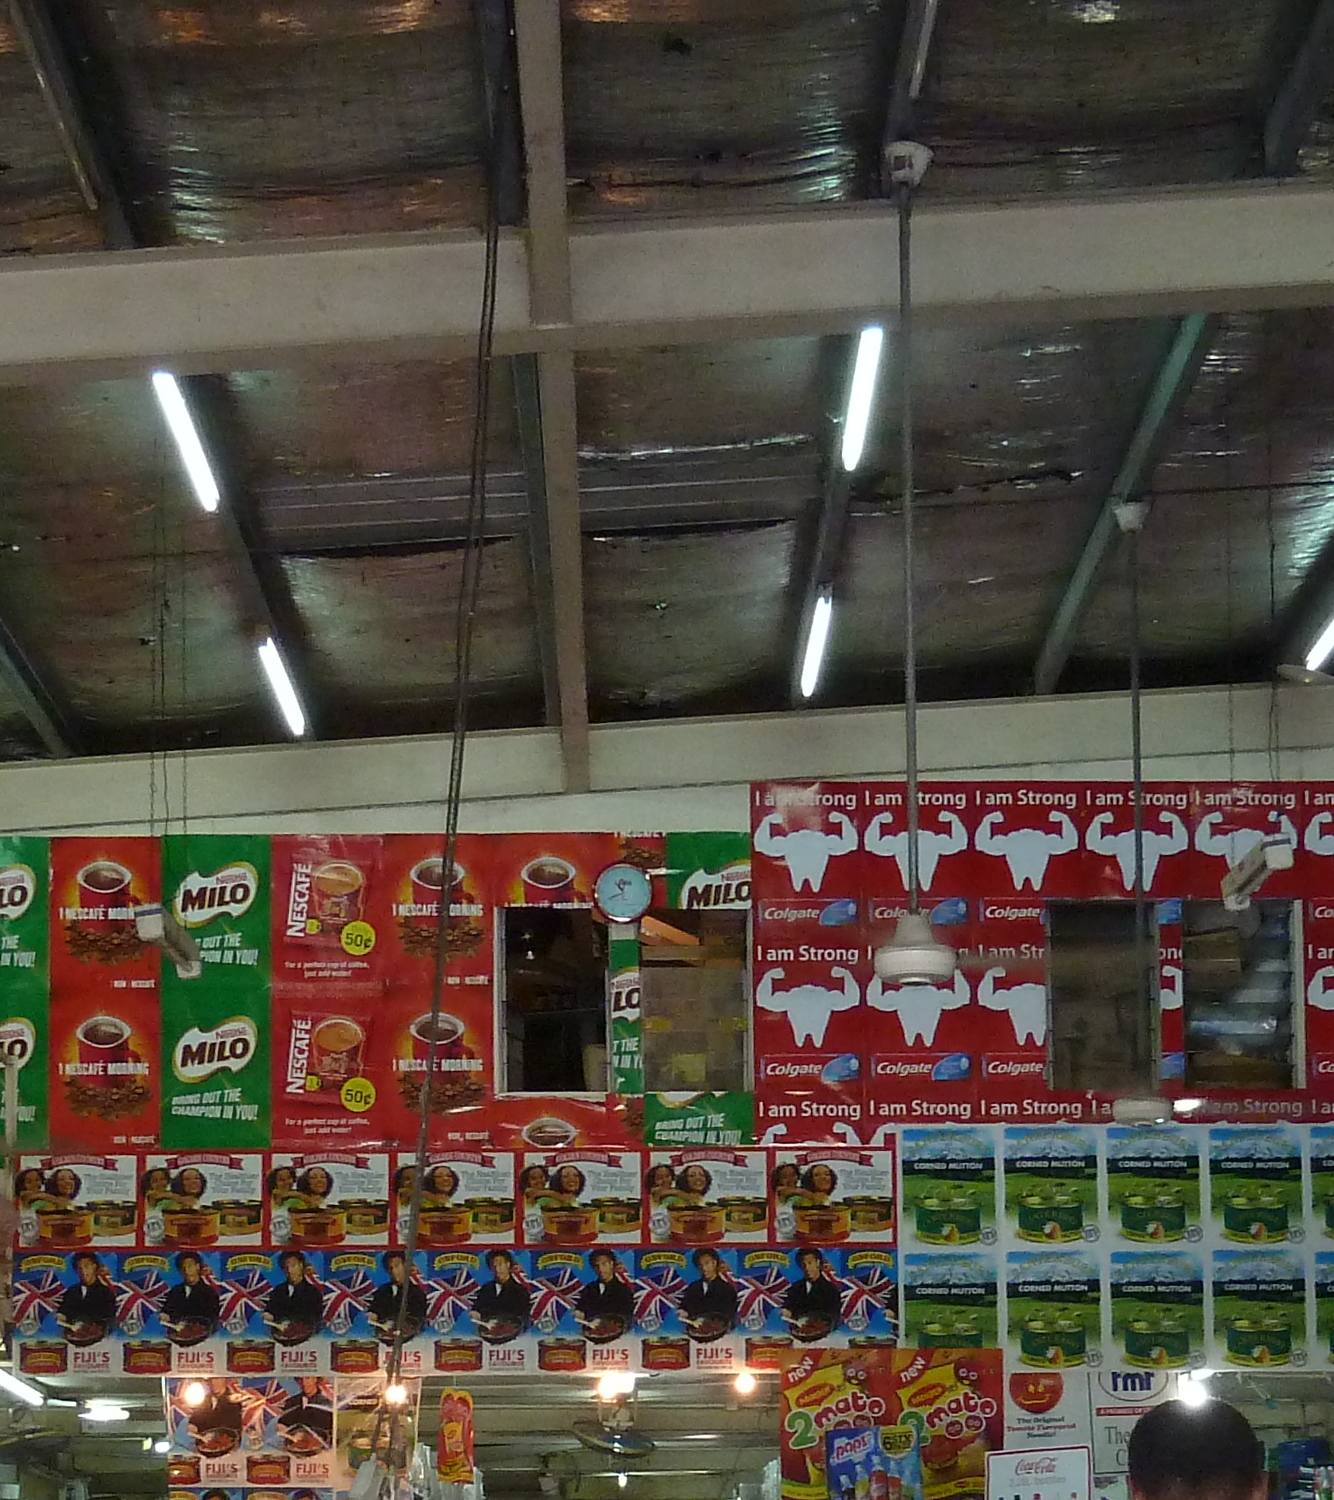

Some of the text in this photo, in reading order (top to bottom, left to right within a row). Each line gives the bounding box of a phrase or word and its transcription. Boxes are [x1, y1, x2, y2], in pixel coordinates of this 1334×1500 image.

[985, 793, 1012, 805] am
[1017, 790, 1077, 808] Strong
[180, 883, 250, 914] MILO
[687, 881, 751, 909] MILO
[765, 907, 820, 921] Colgate
[768, 949, 794, 960] am
[799, 946, 858, 963] Strong
[180, 1037, 250, 1068] MILO
[877, 1062, 932, 1076] Colgate
[879, 1104, 907, 1116] am
[911, 1100, 972, 1119] Strong
[177, 1351, 214, 1364] FIJI'S
[488, 1349, 525, 1363] FIJI'S
[788, 1357, 814, 1383] new
[900, 1356, 926, 1383] new
[785, 1410, 818, 1450] 2
[205, 1462, 238, 1477] FIJI'S
[1015, 1457, 1058, 1476] Coca-Cola
